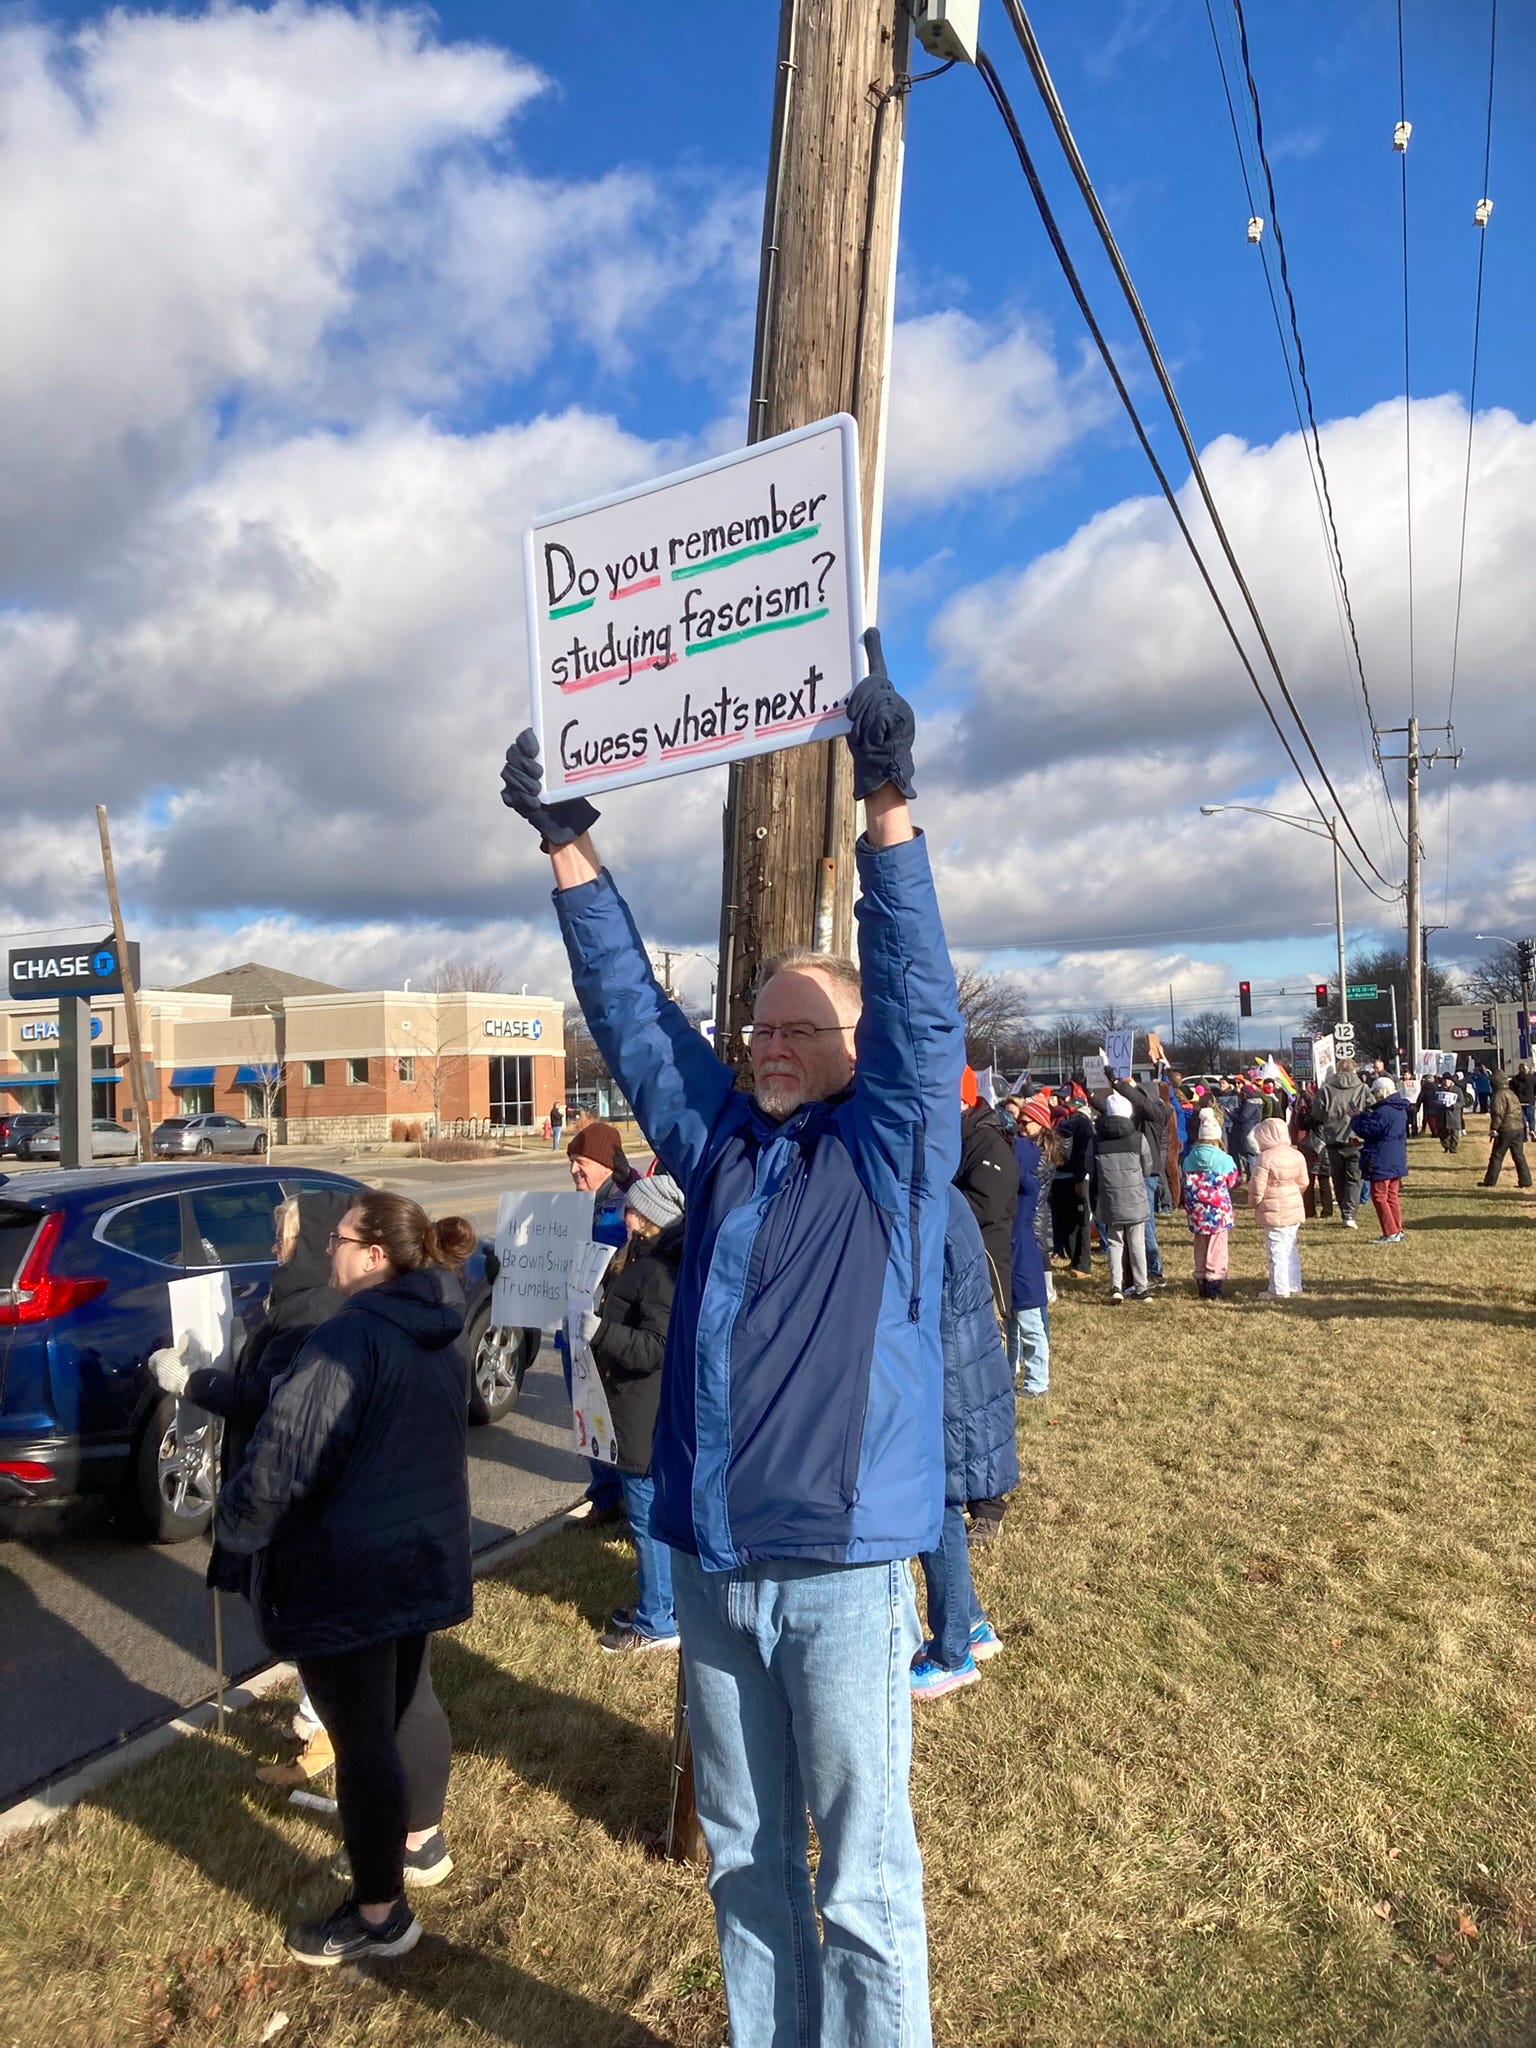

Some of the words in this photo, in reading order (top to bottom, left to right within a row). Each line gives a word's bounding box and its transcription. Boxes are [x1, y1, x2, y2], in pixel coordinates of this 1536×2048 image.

[545, 543, 599, 606] Do
[605, 547, 659, 594] you
[668, 484, 827, 566] remember
[551, 622, 672, 686] studying
[680, 551, 836, 642] fascism?
[560, 720, 648, 771] Guess
[655, 687, 749, 746] what's
[755, 665, 851, 719] next...
[13, 956, 90, 980] CHASE
[22, 1022, 59, 1040] CHA
[485, 1020, 529, 1036] CHASE
[1338, 1026, 1351, 1037] 12
[1107, 1035, 1131, 1059] FCK
[1336, 1046, 1354, 1057] 45
